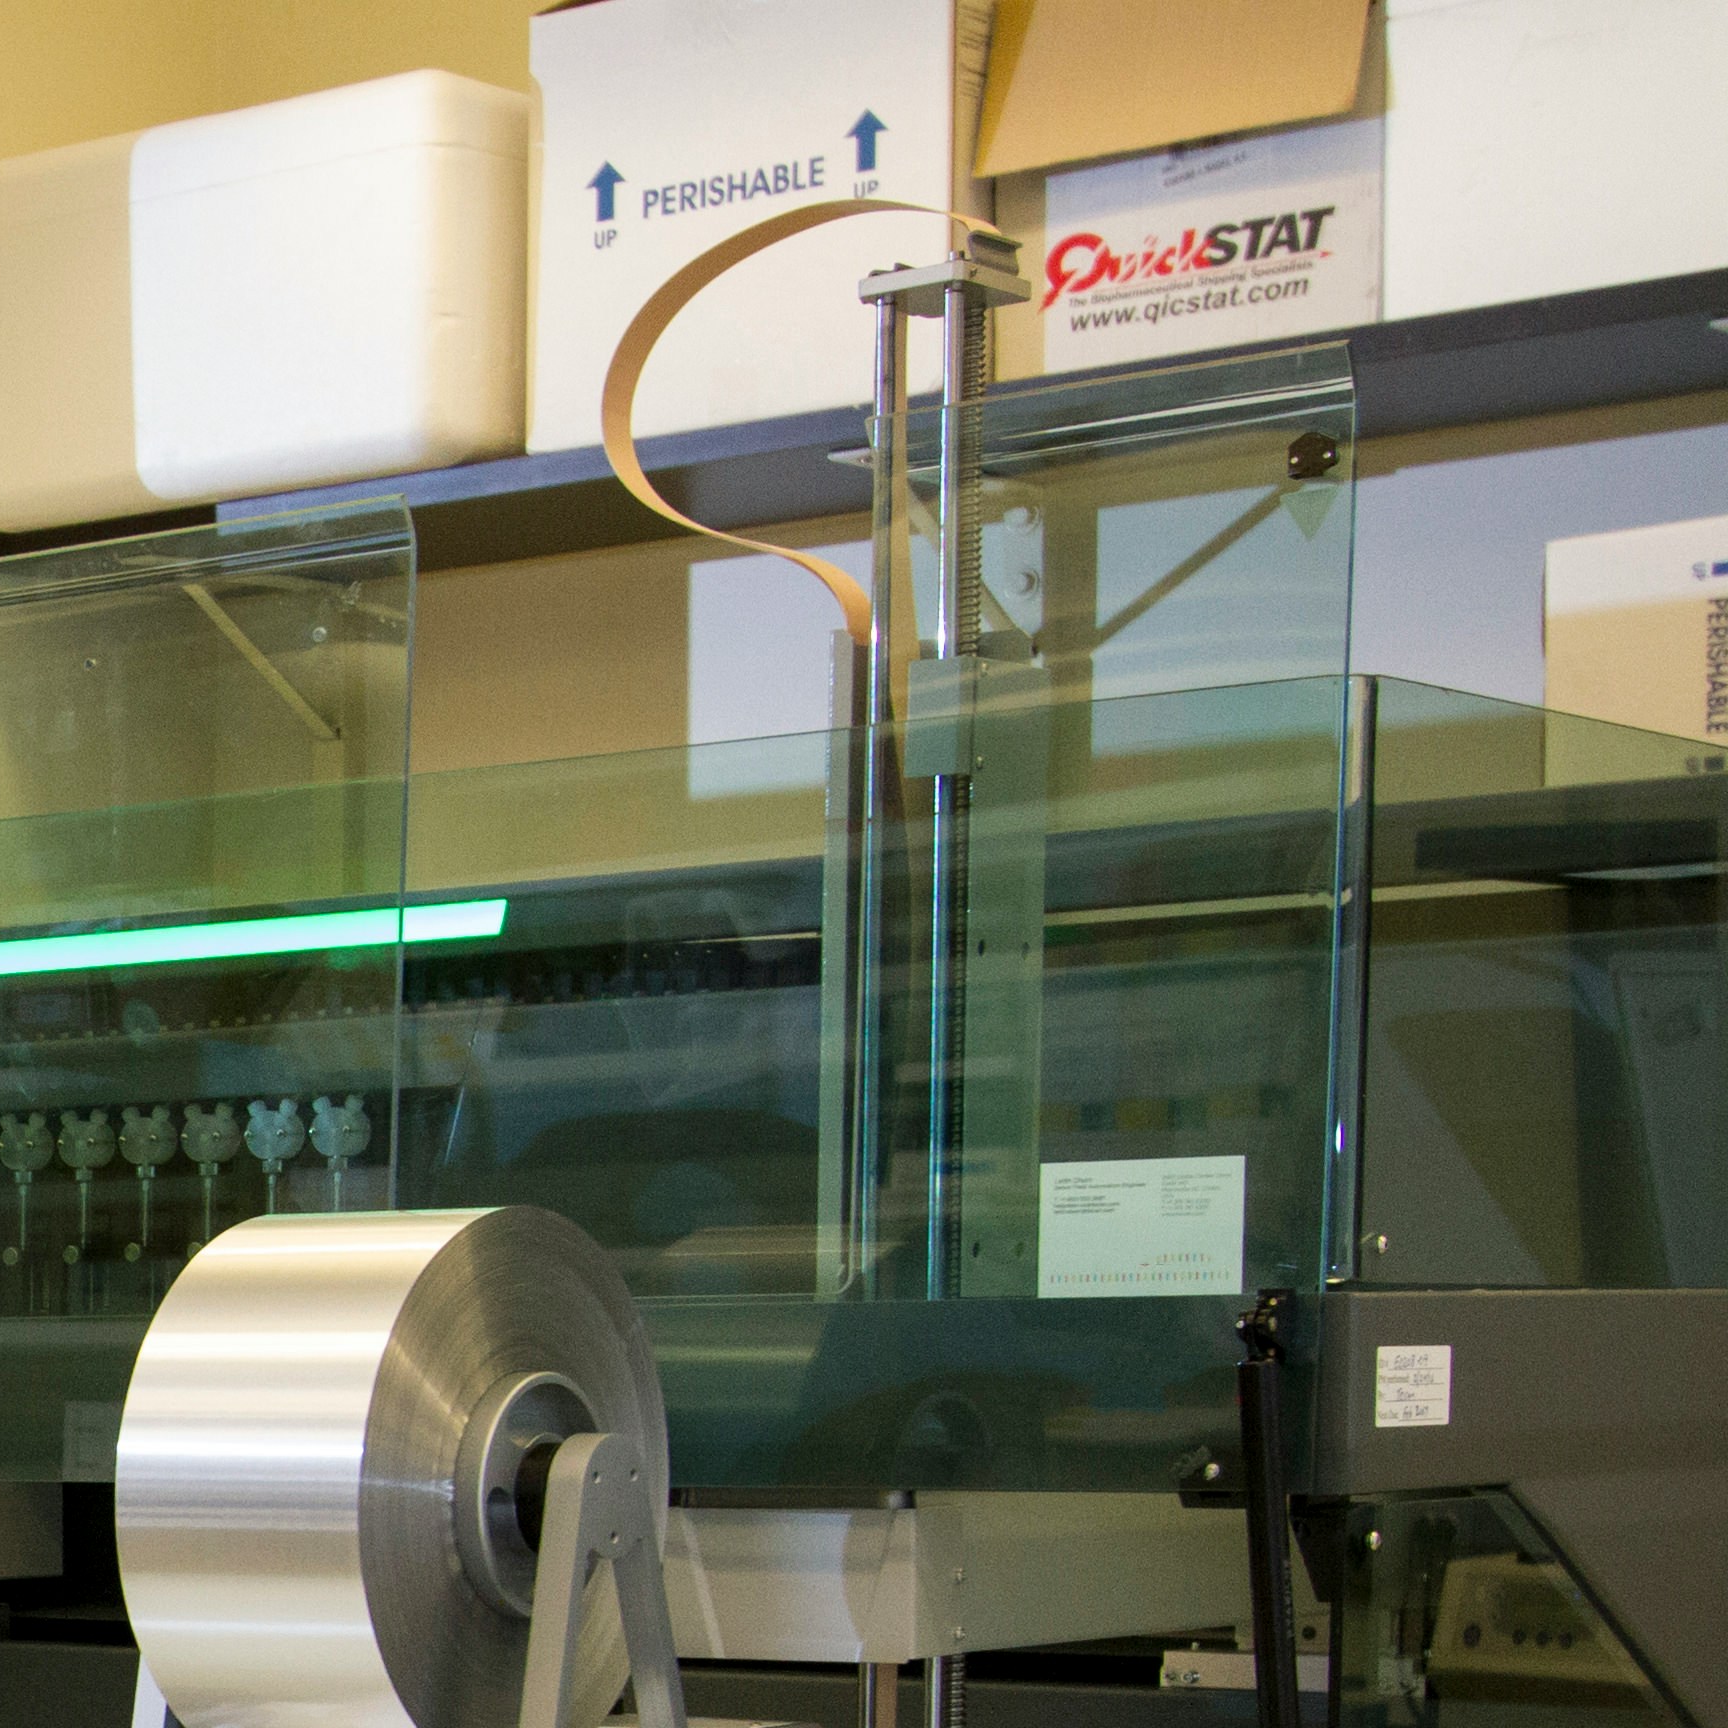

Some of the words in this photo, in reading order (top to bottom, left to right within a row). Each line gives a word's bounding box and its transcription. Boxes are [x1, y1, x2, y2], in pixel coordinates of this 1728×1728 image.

[643, 156, 825, 219] PERISHABLE
[853, 179, 879, 200] UP
[594, 229, 618, 249] UP
[1070, 277, 1310, 332] www.qicstat.com
